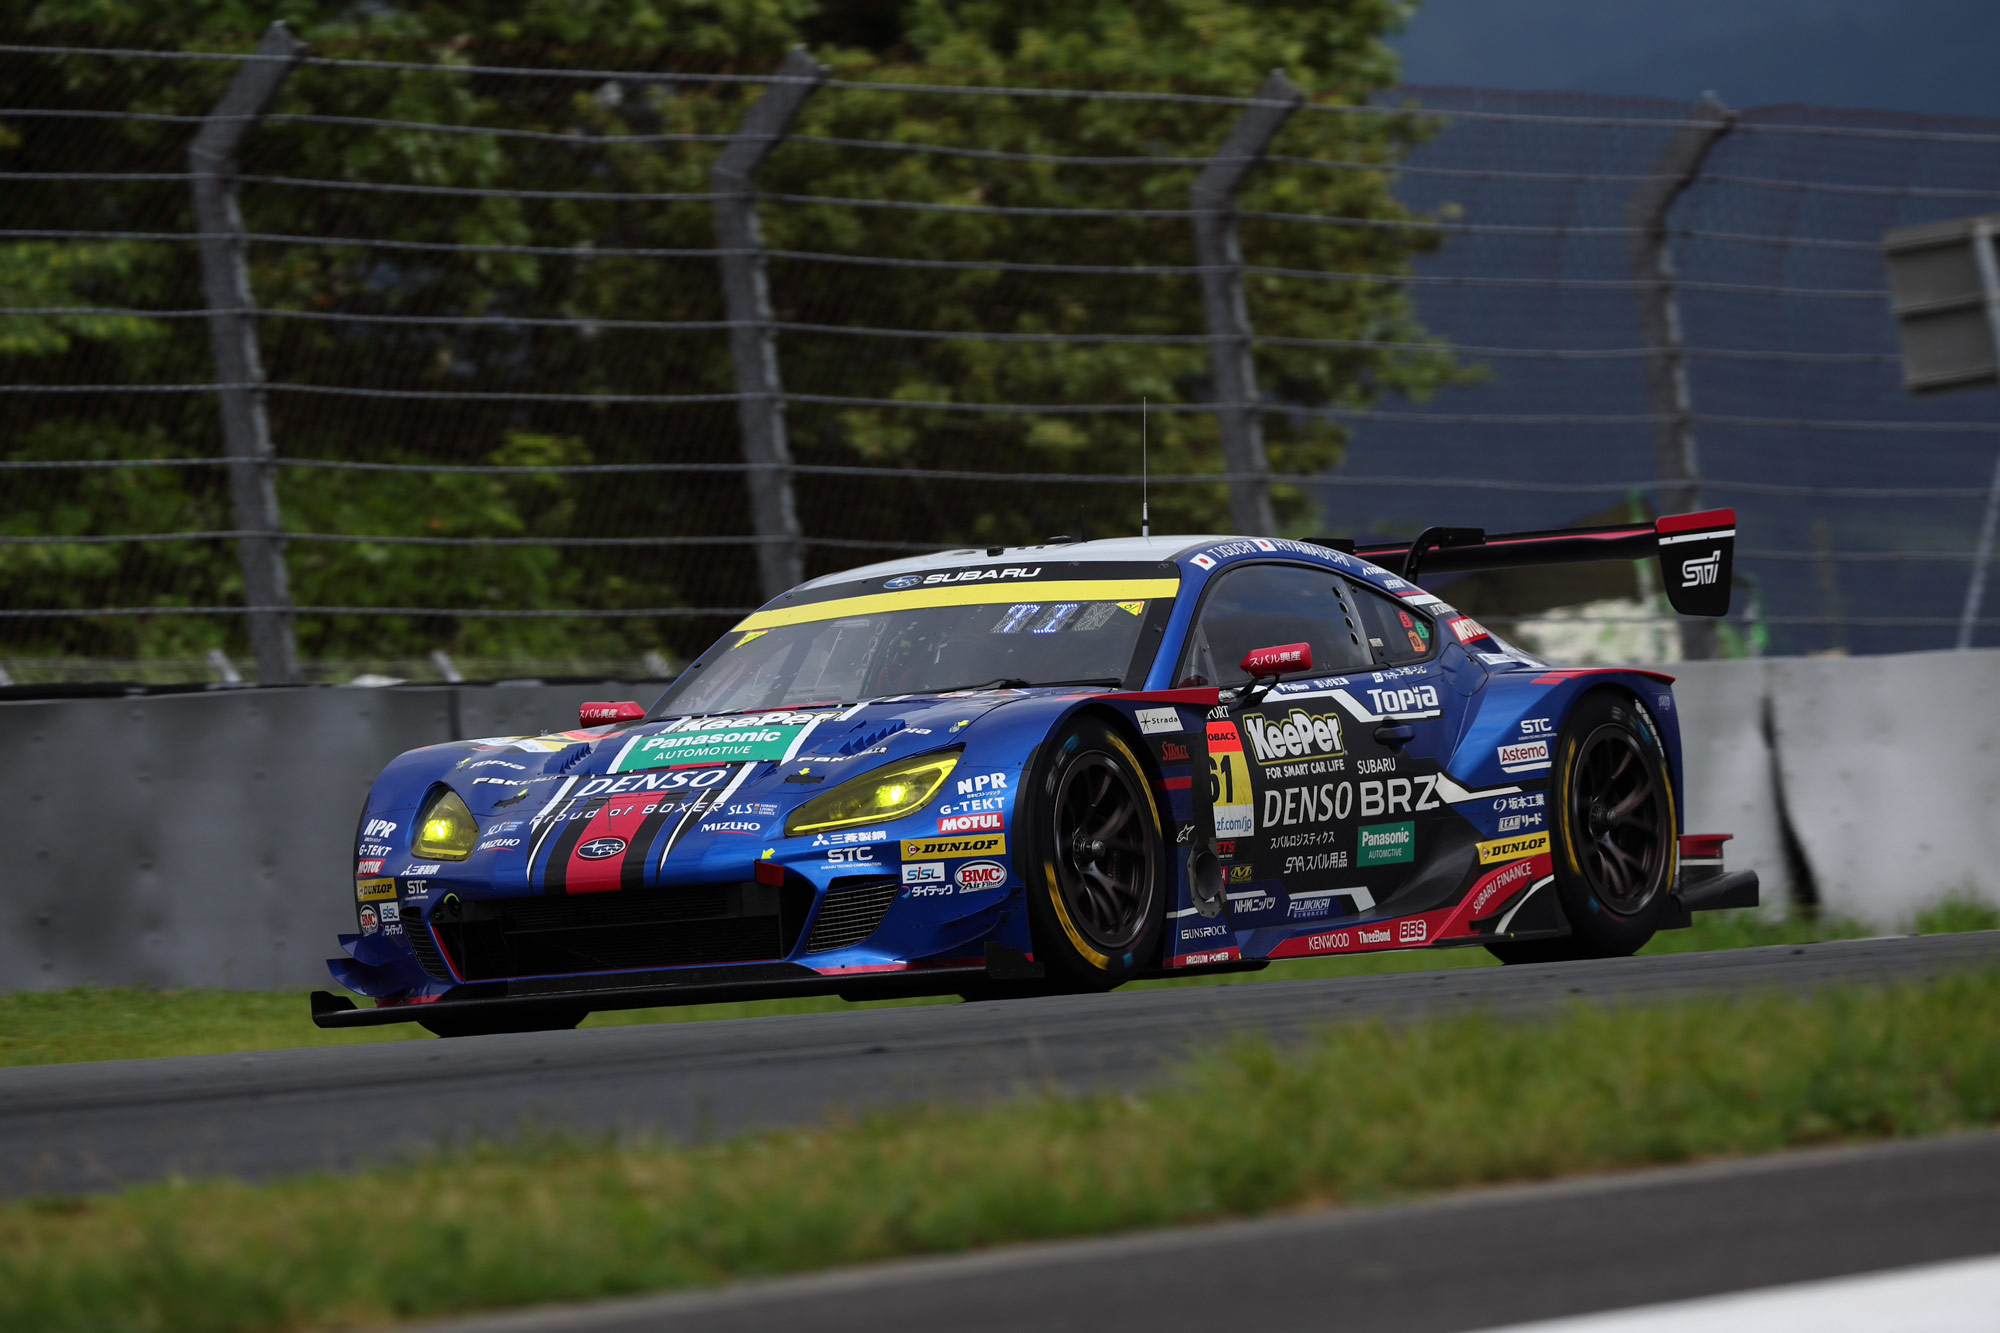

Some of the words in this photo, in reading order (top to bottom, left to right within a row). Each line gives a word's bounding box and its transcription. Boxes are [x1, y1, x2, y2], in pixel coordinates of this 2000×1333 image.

[1207, 541, 1257, 560] T.IGUCHI
[1274, 540, 1351, 567] H.YAMAUCHI
[923, 567, 1041, 584] SUBARU
[1451, 619, 1486, 641] MOTUL
[1250, 650, 1301, 667] スバル興産
[677, 711, 838, 732] KeePer
[1520, 718, 1552, 734] STC
[641, 729, 782, 752] Panasonic
[1208, 732, 1237, 742] OBACS
[1245, 714, 1343, 761] KeePer
[653, 745, 752, 762] AUTOMOTIVE
[1501, 745, 1546, 763] Astemo
[1265, 767, 1283, 779] FOR
[1284, 764, 1309, 777] SMART
[1310, 761, 1325, 774] CAR
[1327, 759, 1345, 772] LIFE
[1356, 757, 1396, 775] SUBARU
[574, 769, 727, 797] DENSO
[957, 772, 1008, 795] NPR
[1359, 774, 1440, 817] BRZ
[1508, 794, 1545, 811] 坂本工業
[728, 803, 754, 816] SLS
[940, 796, 1005, 815] G-TEKT
[1262, 781, 1353, 828] DENSO
[529, 810, 598, 826] Proud
[609, 805, 634, 817] of
[641, 802, 725, 815] BOXER
[1522, 812, 1543, 828] リード
[364, 819, 397, 838] NPR
[701, 822, 761, 833] MIZUHO
[941, 815, 1001, 831] MOTUL
[1216, 819, 1252, 832] zf.com/jp
[477, 839, 521, 851] MIZUHO
[830, 831, 887, 845] 三菱製鋼
[1270, 832, 1335, 849] スバルロジスティクス
[1362, 827, 1410, 847] Panasonic
[359, 844, 392, 857] G-TEKT
[827, 846, 874, 863] STC
[922, 840, 998, 853] DUNLOP
[1368, 848, 1402, 859] AUTOMOTIVE
[1492, 838, 1546, 857] DUNLOP
[358, 860, 382, 874] MOTUL
[1306, 851, 1348, 871] スバル用品
[961, 868, 1000, 883] BMC
[364, 884, 392, 895] DUNLOP
[407, 880, 428, 894] STC
[911, 884, 953, 897] ダイテック
[962, 882, 981, 890] Air
[1473, 877, 1497, 915] SUBARU
[1497, 862, 1532, 889] FINANCE
[362, 913, 376, 926] BMC
[1181, 925, 1227, 940] GUNSROCK
[1358, 930, 1391, 944] ThreeBond
[1400, 920, 1427, 942] BBS
[1308, 933, 1350, 950] KENWOOD
[1186, 955, 1209, 964] IRIDIUM
[1209, 951, 1229, 962] POWER
